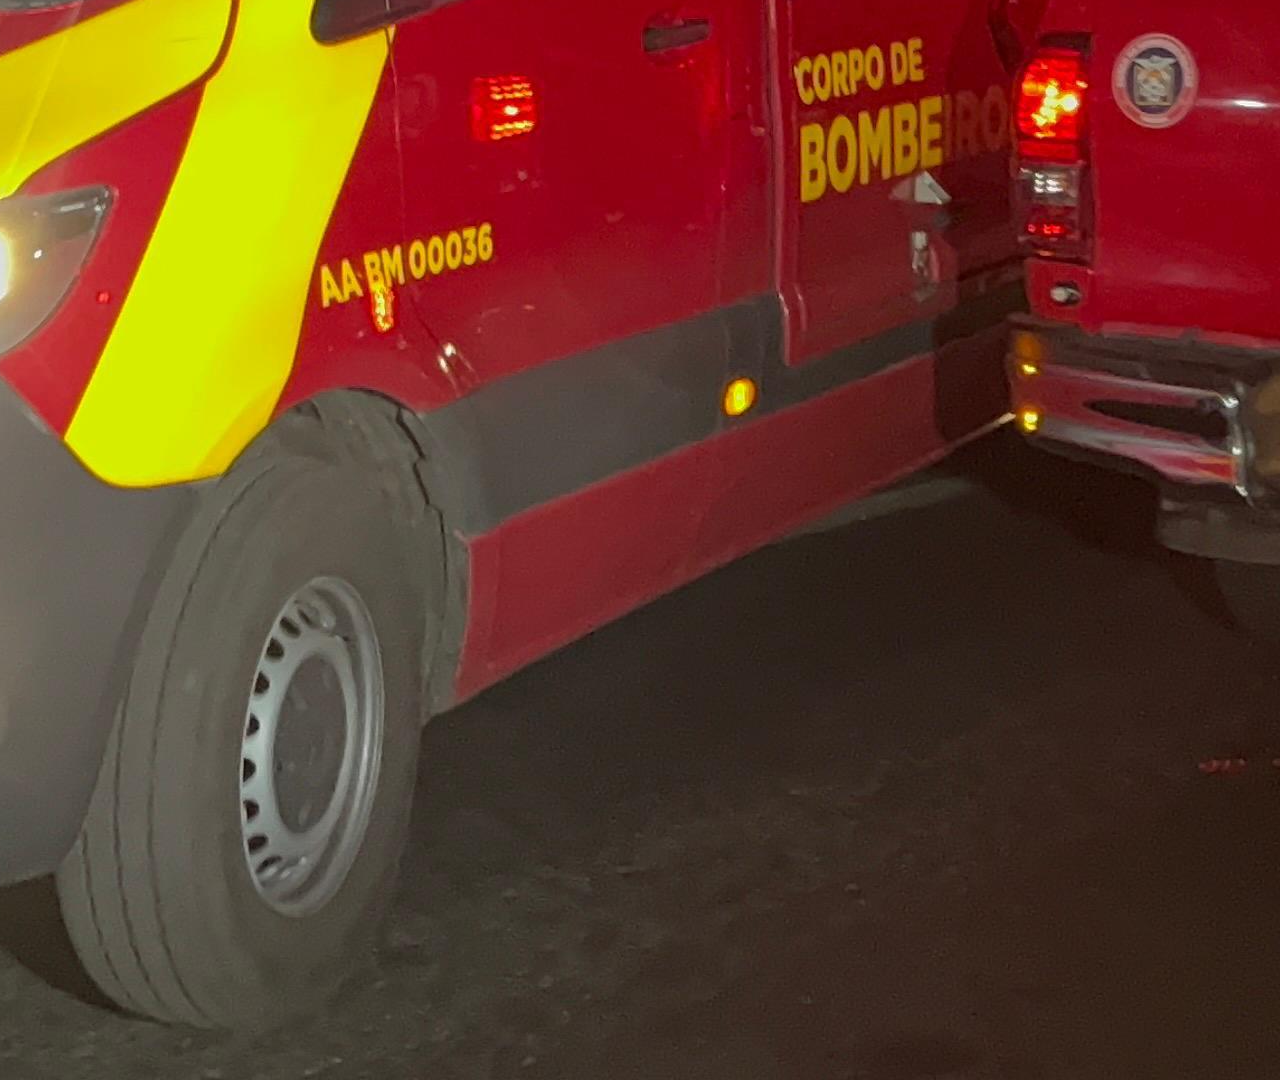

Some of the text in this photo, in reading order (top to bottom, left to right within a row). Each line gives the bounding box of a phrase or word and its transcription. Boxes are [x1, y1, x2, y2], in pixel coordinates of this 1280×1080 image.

[793, 37, 926, 105] CORPO DE
[799, 84, 1011, 203] BOMBEIRO
[320, 222, 494, 308] AA BM 00036
